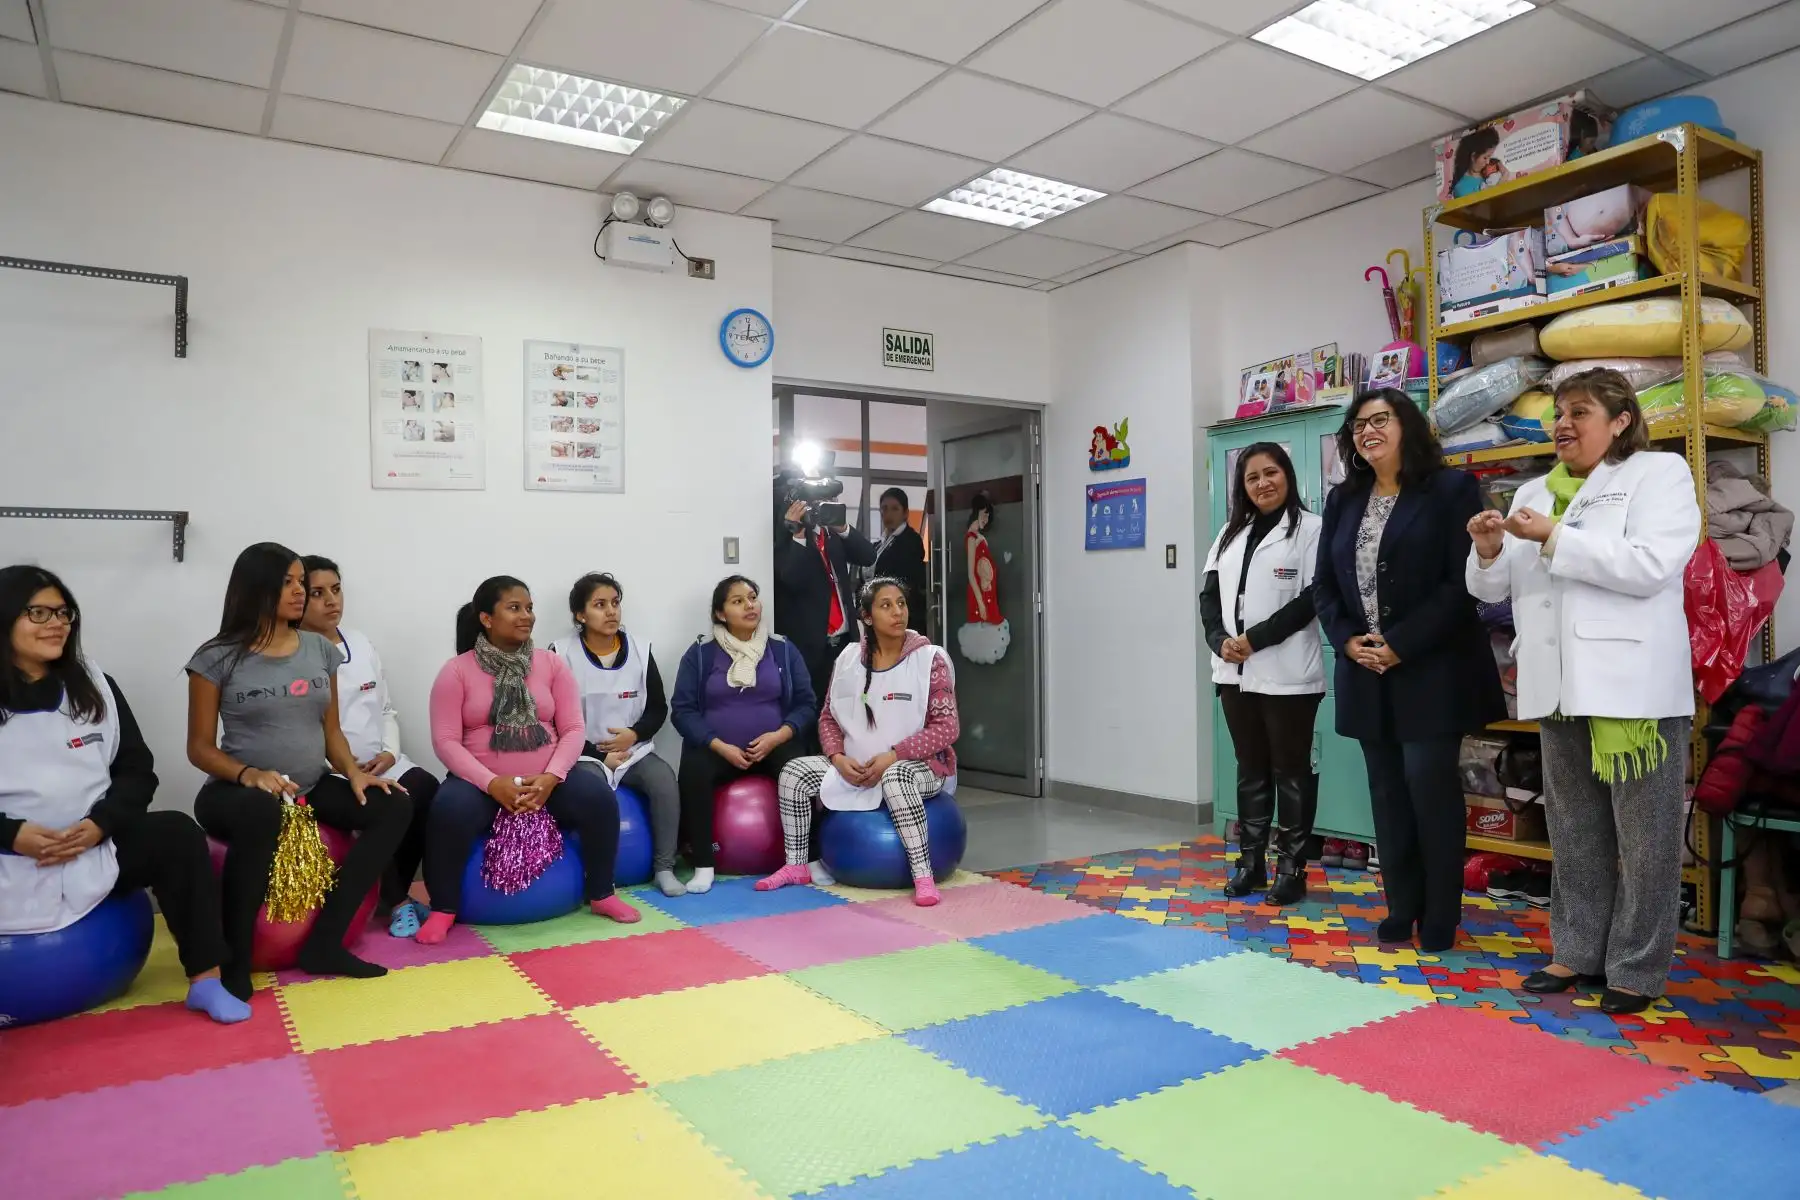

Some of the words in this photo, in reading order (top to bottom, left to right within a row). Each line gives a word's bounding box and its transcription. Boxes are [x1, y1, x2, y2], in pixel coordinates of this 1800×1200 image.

[886, 334, 930, 356] SALIDA
[886, 353, 893, 362] DE
[895, 354, 931, 366] EMERGENCIA
[1479, 813, 1505, 824] SODA
